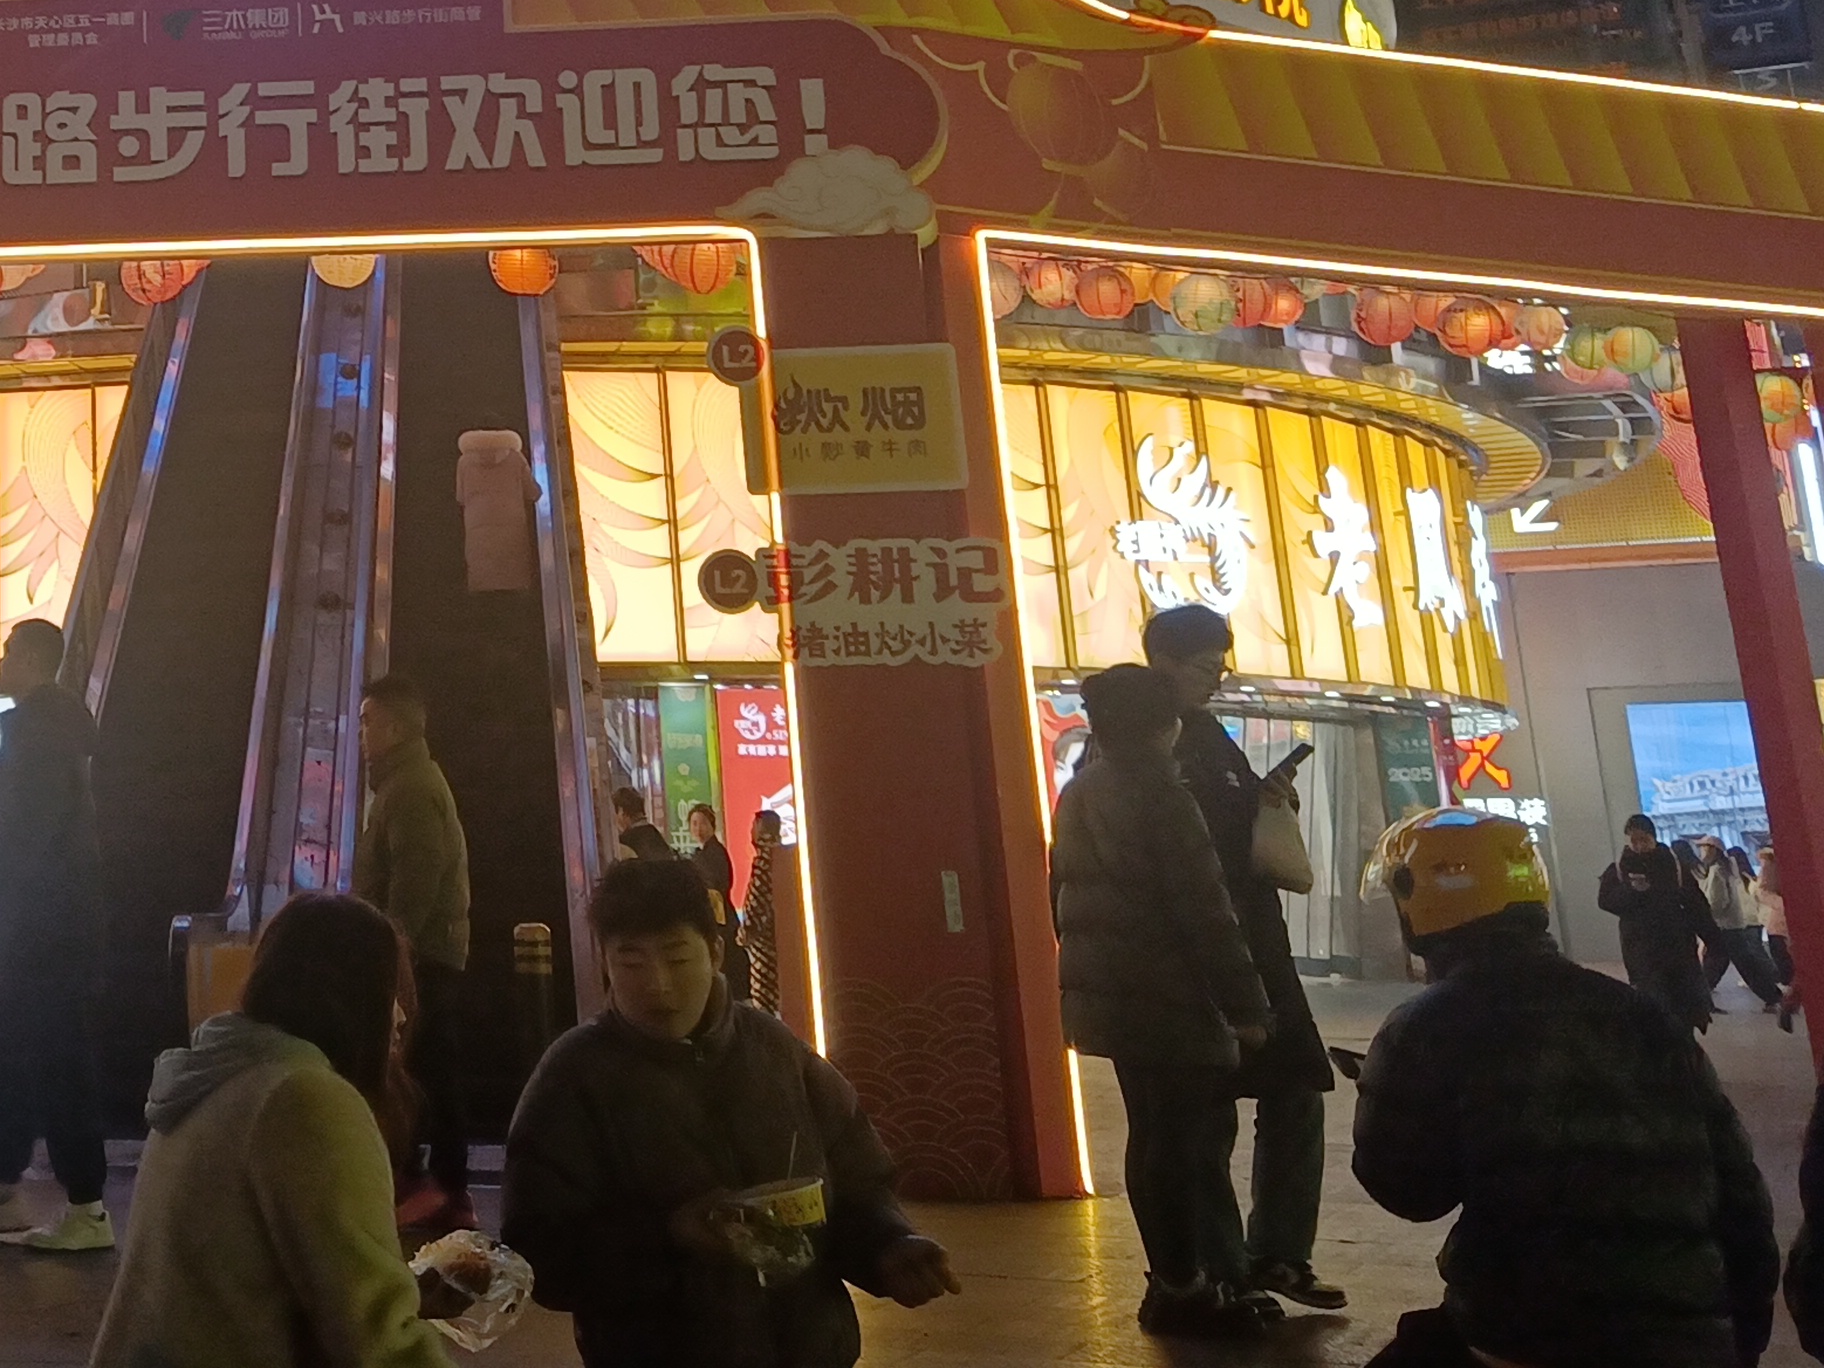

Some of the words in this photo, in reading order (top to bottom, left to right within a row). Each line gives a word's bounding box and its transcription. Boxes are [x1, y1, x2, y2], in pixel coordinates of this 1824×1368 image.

[201, 7, 289, 30] 三木集团
[1731, 21, 1776, 46] 4F
[721, 343, 758, 367] L2
[792, 438, 929, 462] 小炒黄牛肉
[713, 568, 750, 594] L2
[762, 544, 1006, 605] 彭耕记
[783, 617, 992, 660] 猪油炒小菜
[1387, 766, 1433, 783] 2025
